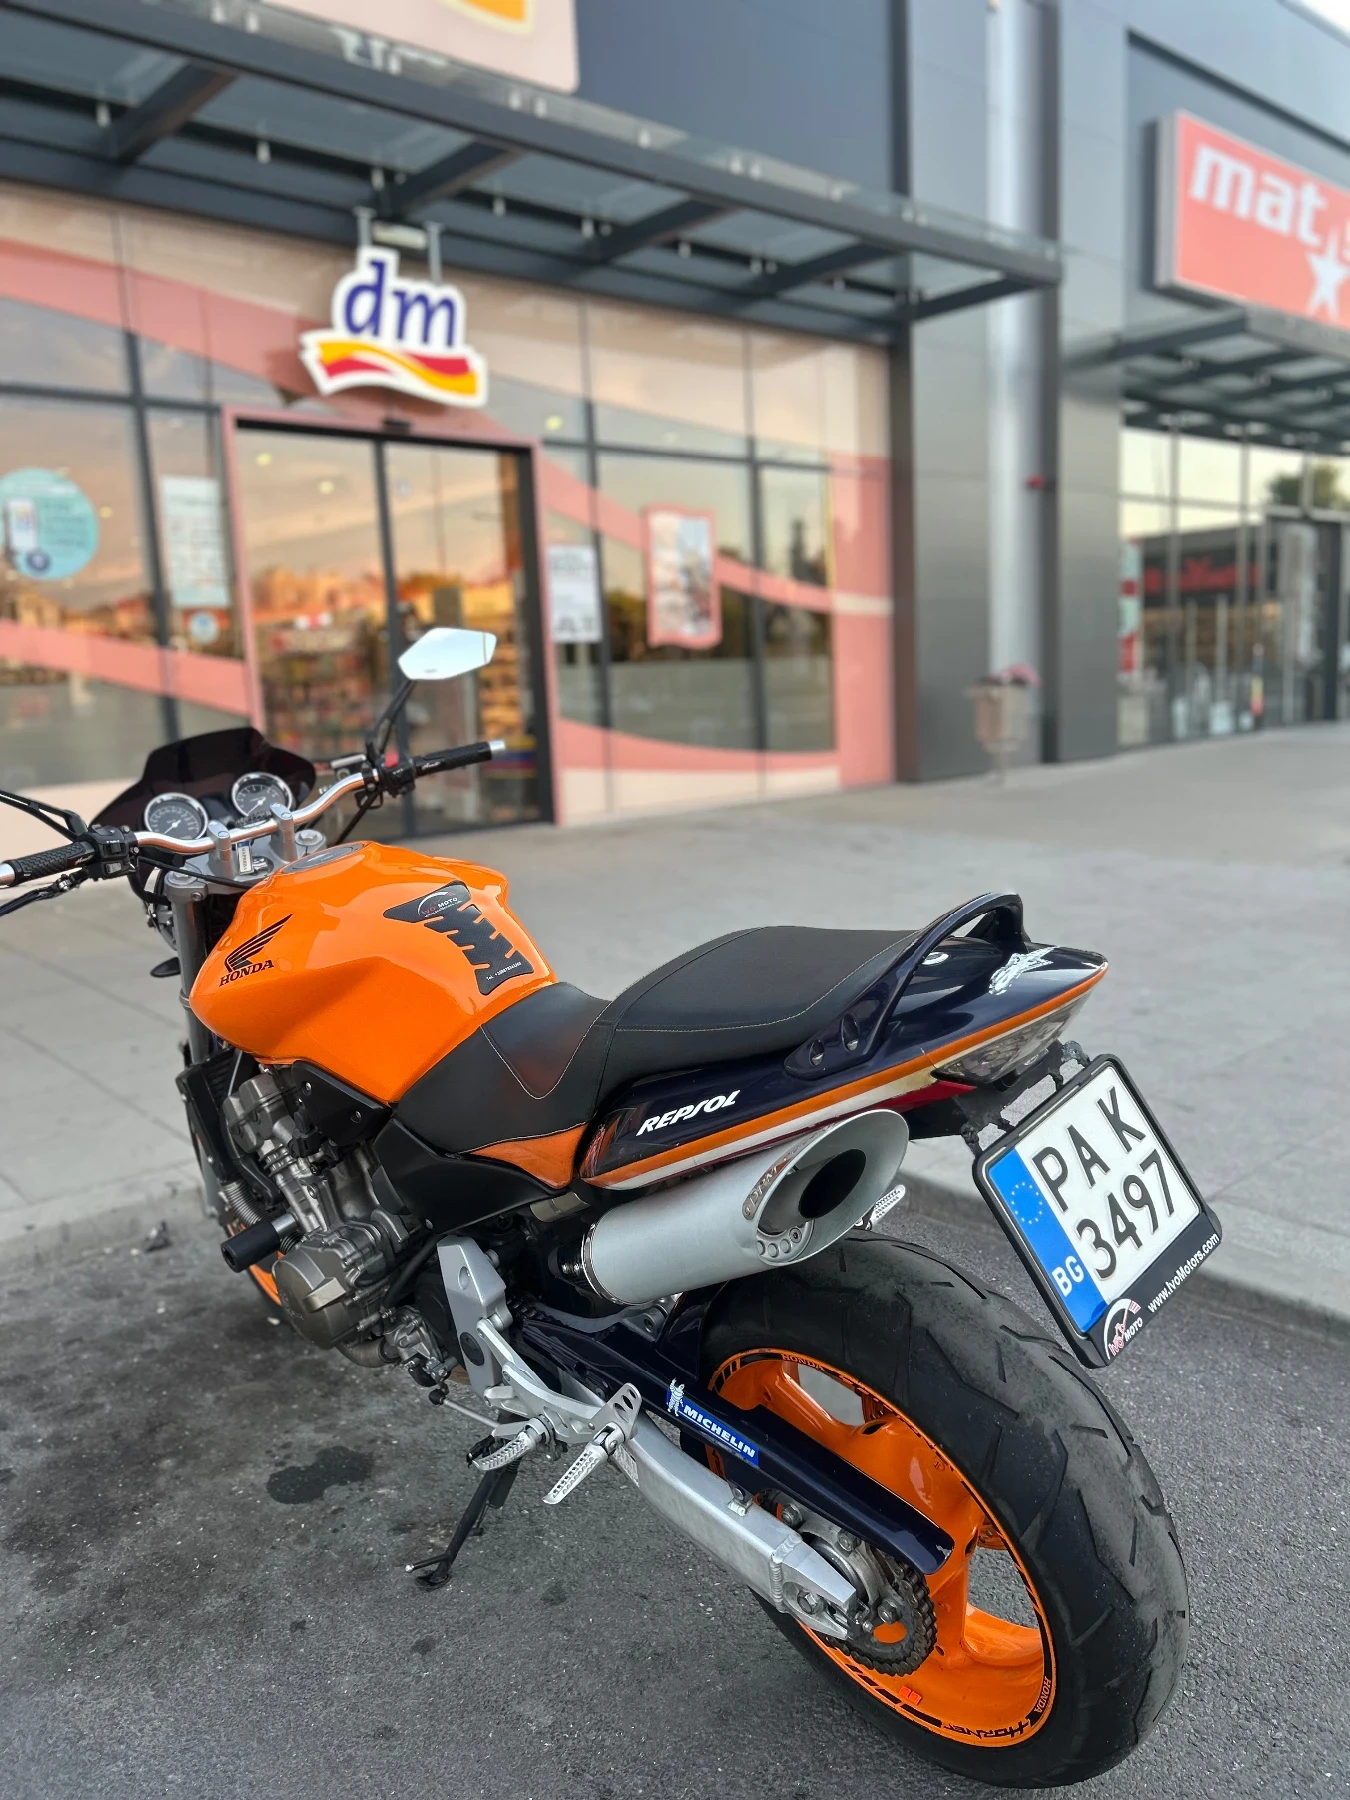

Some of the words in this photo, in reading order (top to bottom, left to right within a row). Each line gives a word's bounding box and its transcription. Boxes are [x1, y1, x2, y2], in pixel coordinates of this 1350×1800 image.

[345, 260, 456, 348] dm
[437, 897, 458, 908] MOTO
[219, 960, 274, 987] HONDA
[636, 1090, 740, 1136] REPSOL
[1077, 1148, 1174, 1280] 3497
[1052, 1255, 1084, 1297] BG
[1147, 1233, 1220, 1313] www.IvoMotors.com
[1124, 1316, 1143, 1342] MOTO
[781, 1353, 824, 1372] HONDA
[683, 1405, 756, 1458] MICHELIN
[1033, 1676, 1051, 1714] HONDA
